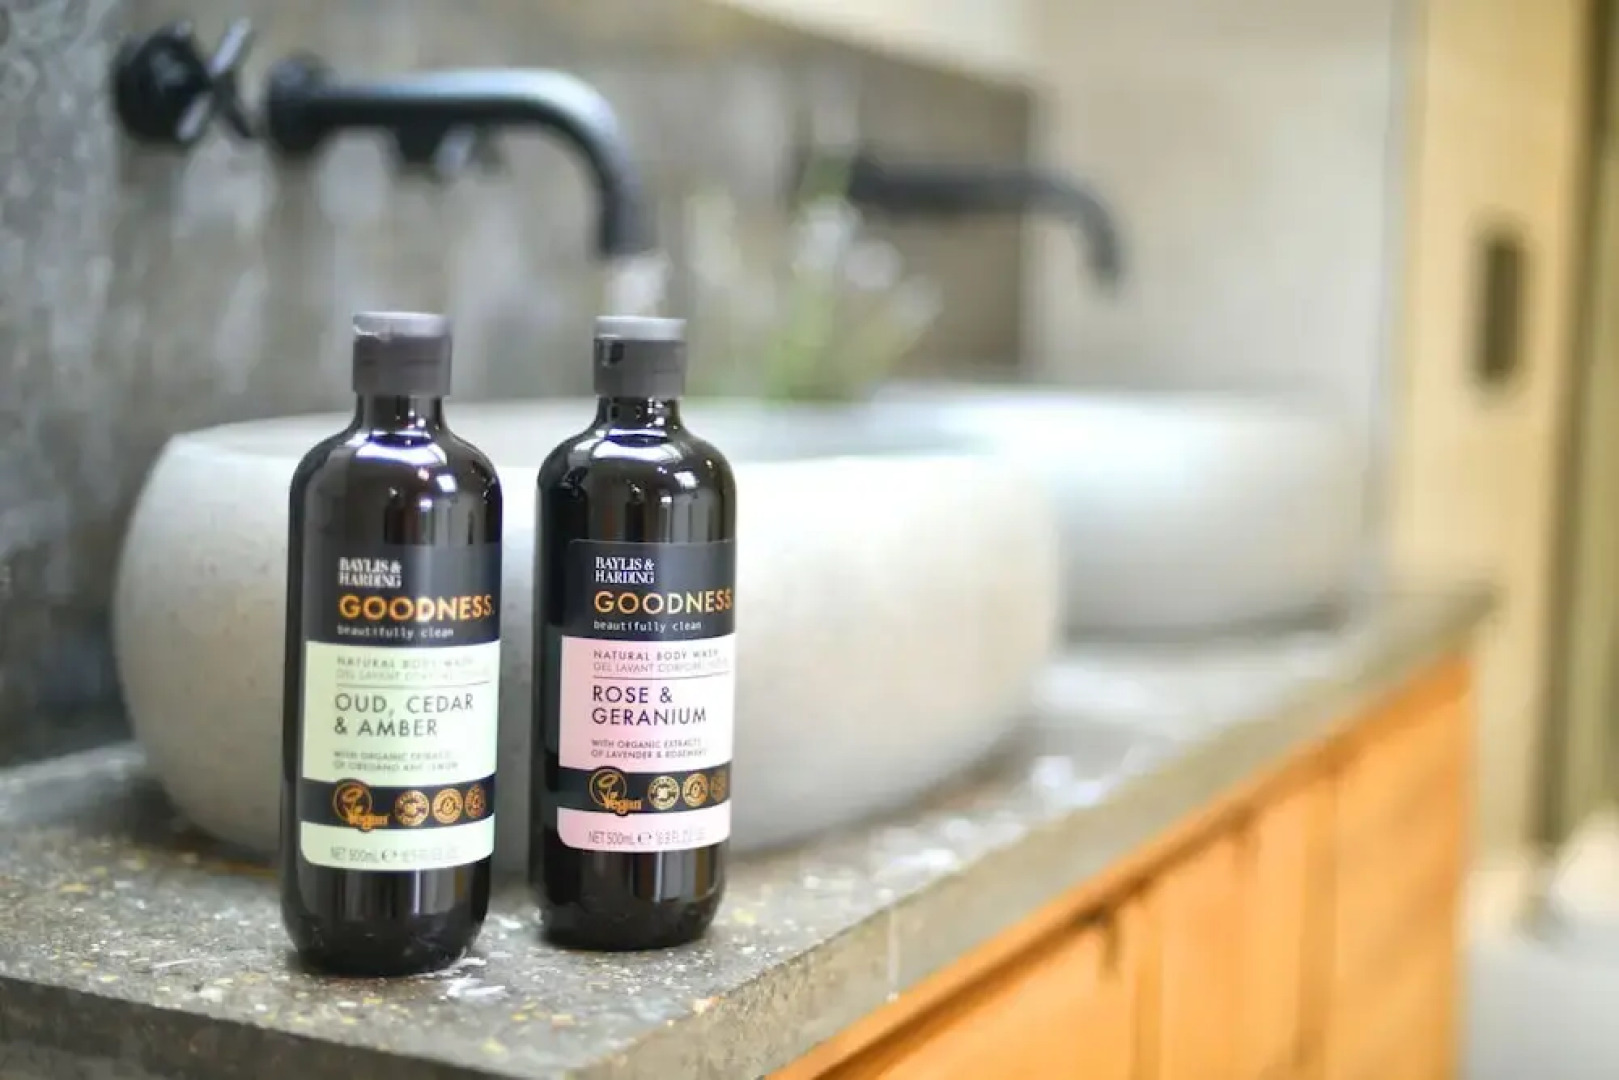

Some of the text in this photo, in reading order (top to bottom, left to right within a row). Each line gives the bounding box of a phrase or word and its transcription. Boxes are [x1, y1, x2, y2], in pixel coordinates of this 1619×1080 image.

[338, 557, 402, 574] BAYLIS &
[595, 556, 655, 570] BAYLIS &
[338, 573, 402, 588] HARDING
[595, 570, 655, 584] HARDING
[337, 624, 454, 640] beautifully clean
[593, 620, 702, 634] beautifully clean
[593, 650, 650, 661] NATURAL
[656, 651, 687, 661] BODY
[593, 684, 673, 703] ROSE &
[334, 692, 474, 717] OUD, CEDAR
[591, 706, 707, 726] GERANIUM
[334, 716, 438, 736] & AMBER
[591, 739, 614, 747] WITH
[617, 740, 661, 749] ORGANIC
[590, 749, 603, 758] OF
[606, 750, 651, 760] LAVENDER
[600, 793, 642, 814] Vegan
